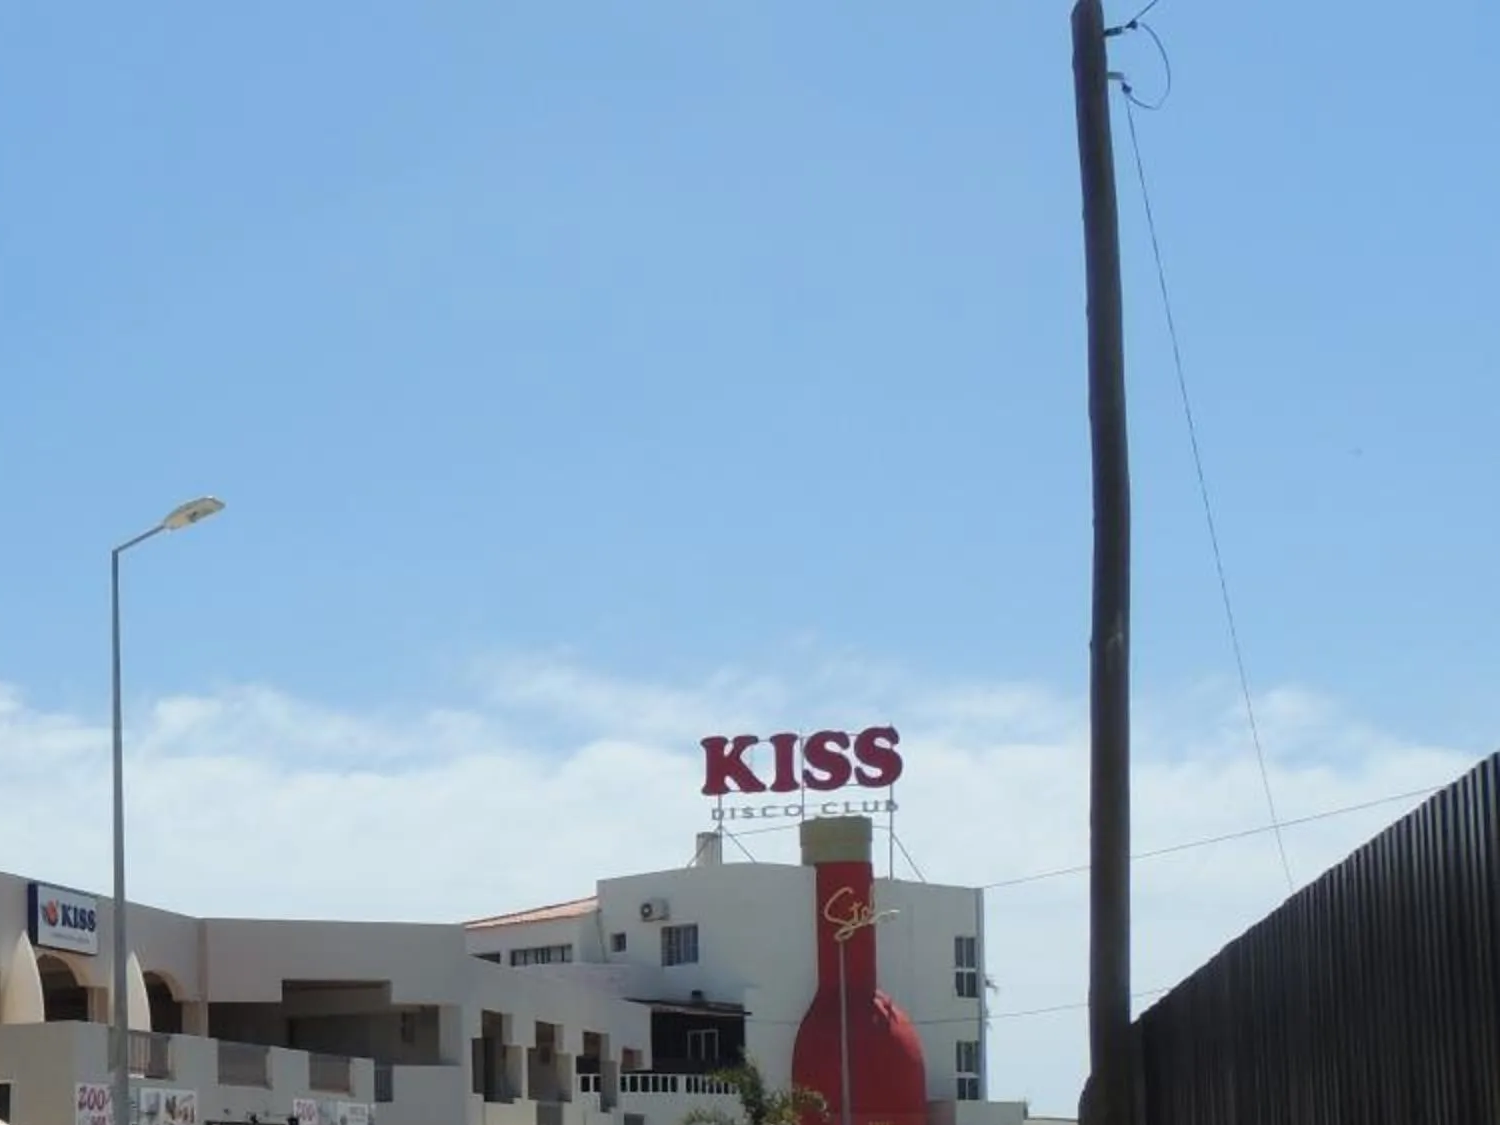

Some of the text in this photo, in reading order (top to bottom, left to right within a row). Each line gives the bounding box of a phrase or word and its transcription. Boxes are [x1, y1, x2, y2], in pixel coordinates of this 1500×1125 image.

[700, 727, 903, 796] KISS
[711, 799, 898, 821] DISCO CLUB
[61, 904, 96, 932] KISS
